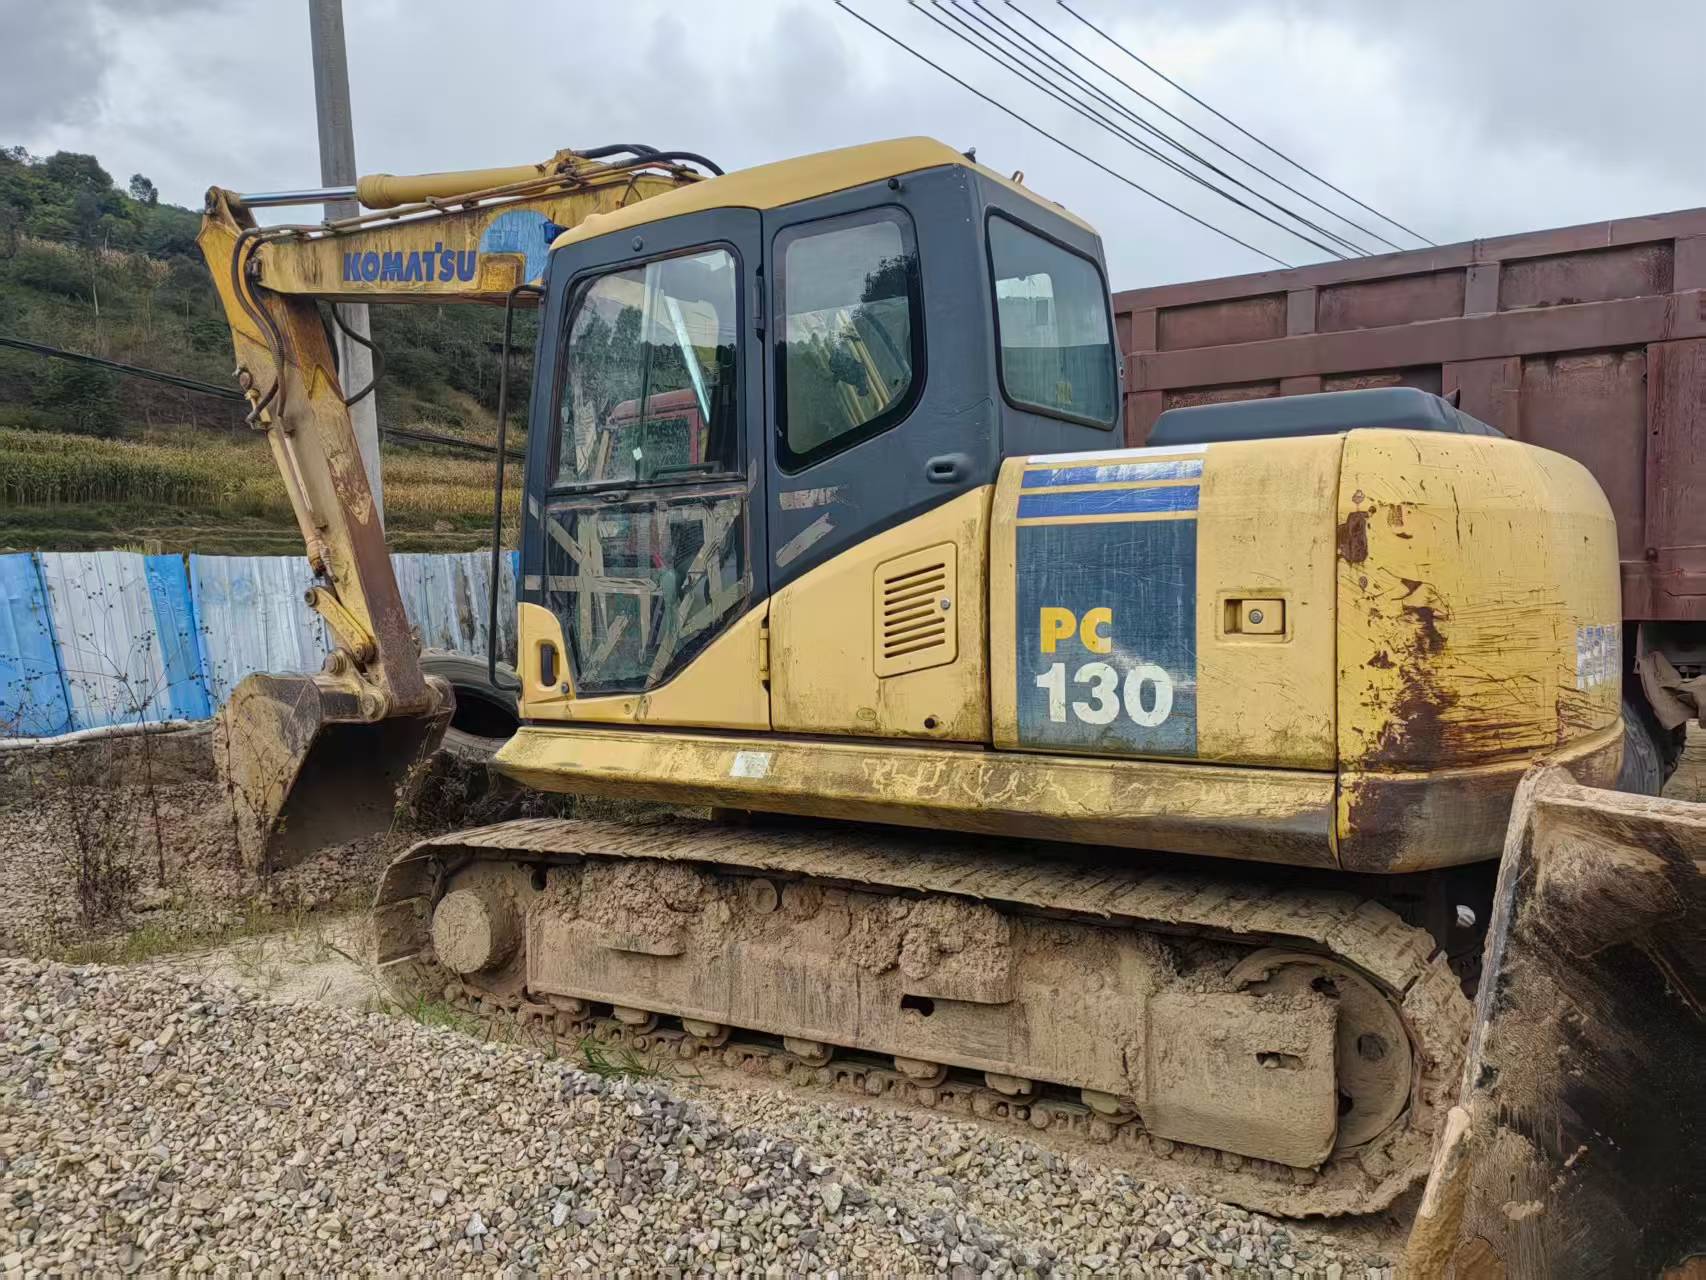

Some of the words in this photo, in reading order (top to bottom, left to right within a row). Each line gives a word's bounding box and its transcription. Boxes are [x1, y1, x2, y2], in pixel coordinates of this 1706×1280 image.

[343, 242, 476, 282] KOMATSU
[1040, 607, 1112, 654] PC
[1037, 662, 1173, 727] 130
